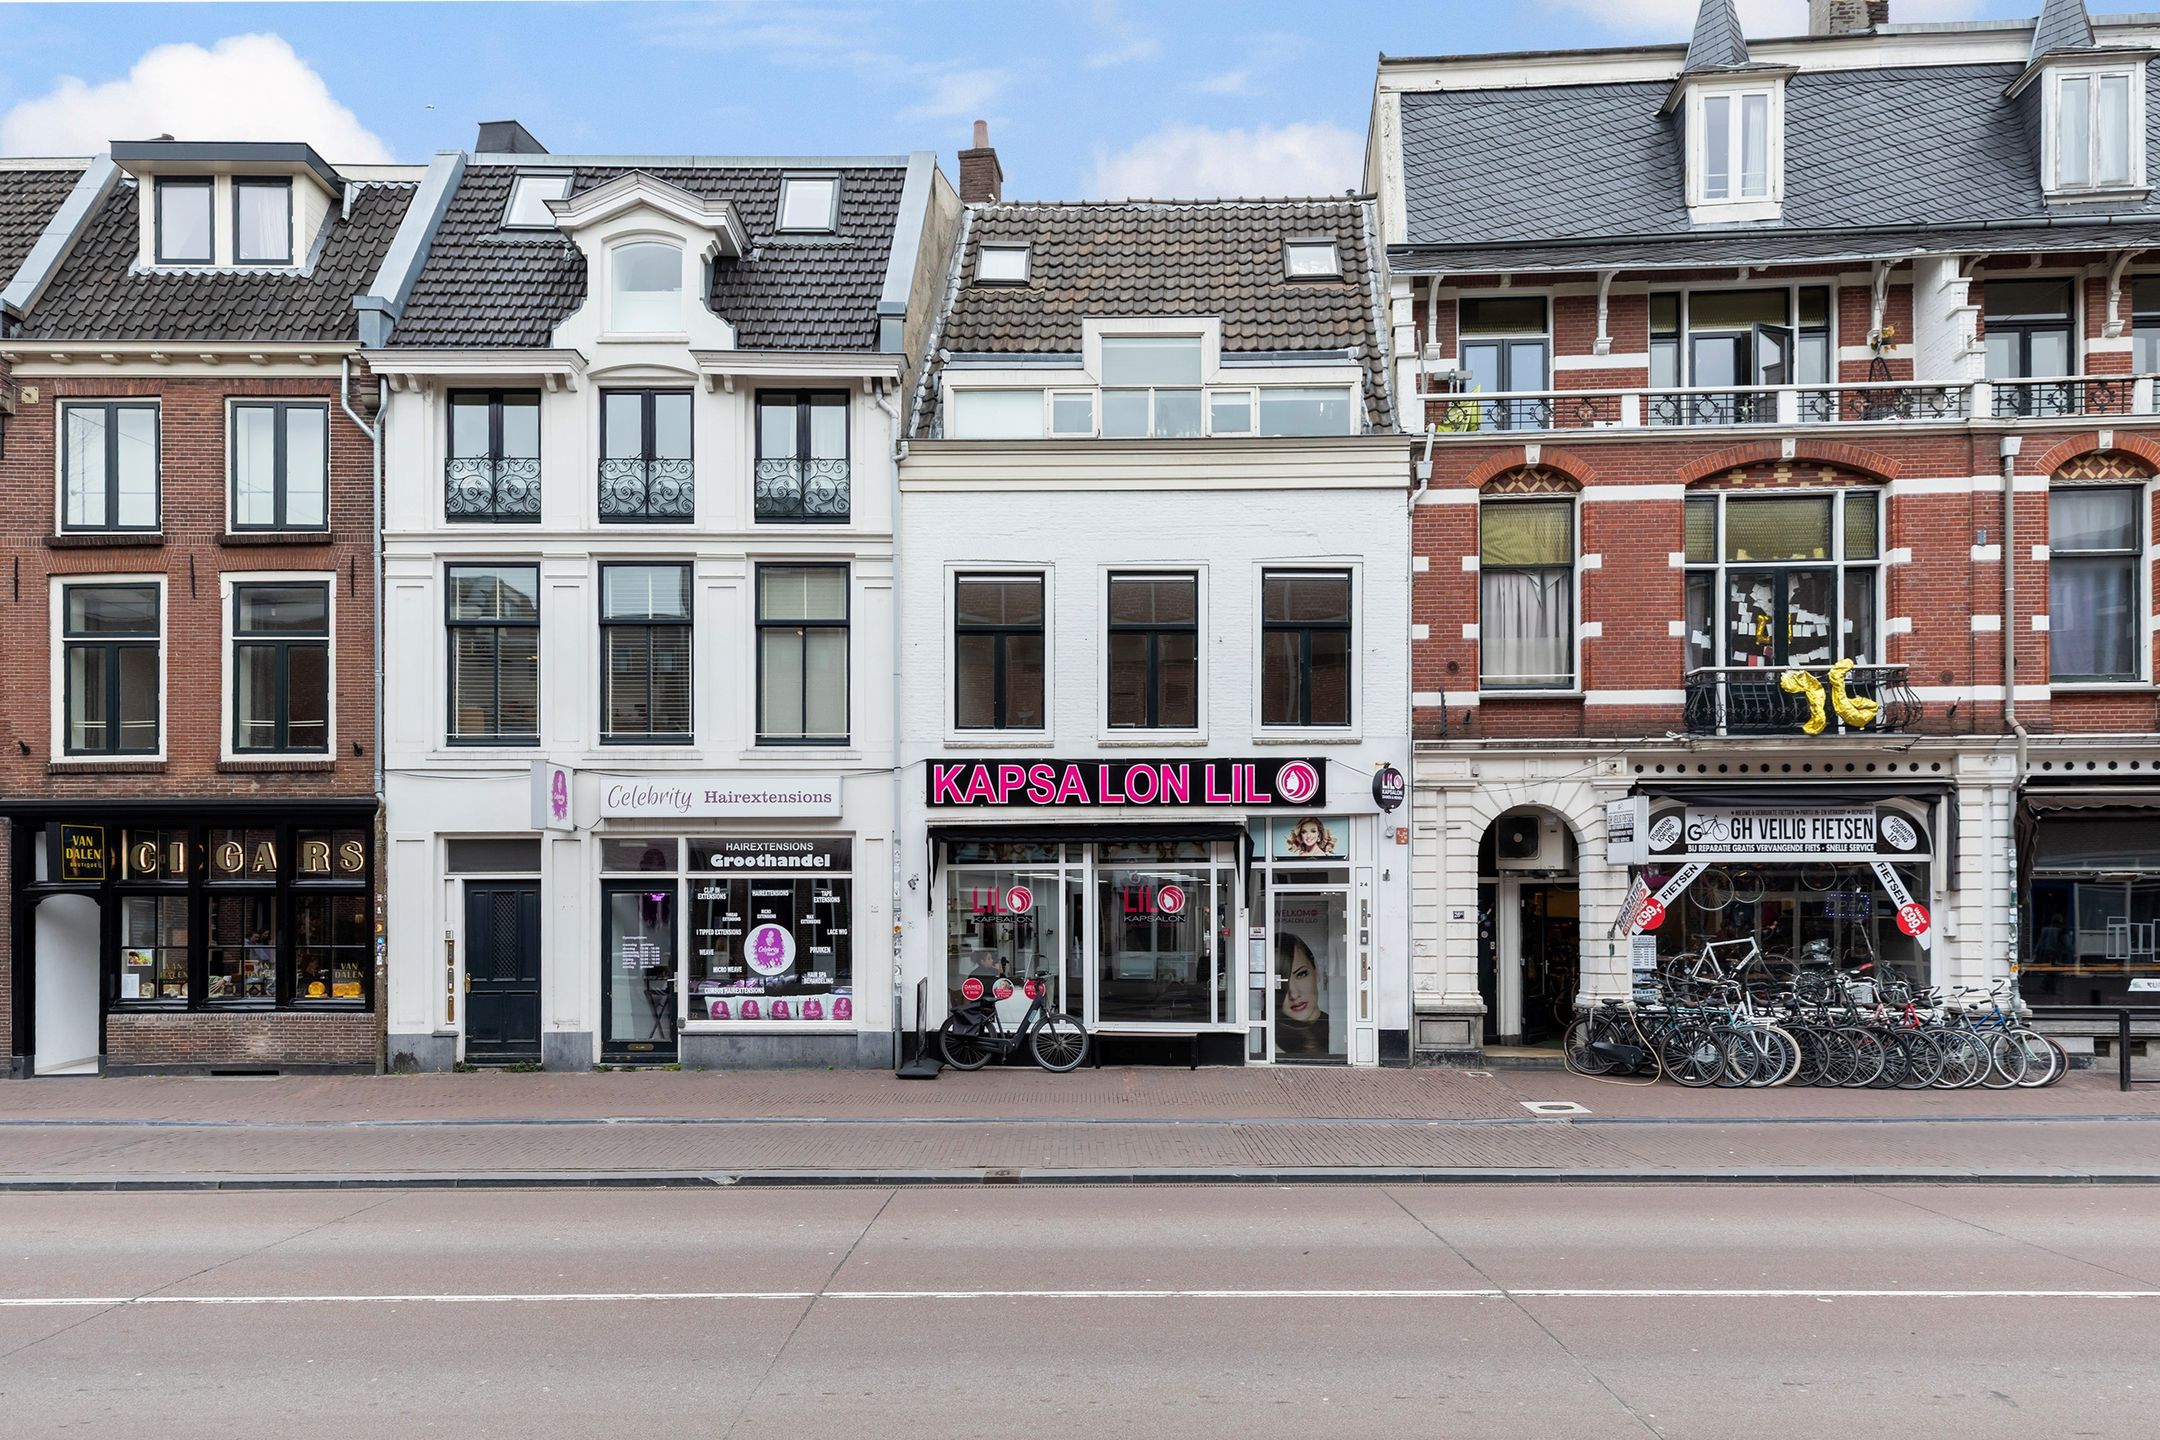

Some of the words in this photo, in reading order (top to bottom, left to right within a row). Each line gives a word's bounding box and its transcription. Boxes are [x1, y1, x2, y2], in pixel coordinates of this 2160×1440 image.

[1205, 764, 1272, 804] LIL
[608, 785, 692, 814] Celebrity
[704, 790, 832, 804] Hairextensions
[1650, 818, 1671, 841] STUDENTEN
[1657, 824, 1674, 842] KORTING
[1731, 818, 1752, 839] GH
[1759, 818, 1806, 839] VEILIG
[1812, 818, 1873, 839] FIETSEN
[1890, 825, 1909, 843] KORTING
[1892, 818, 1915, 840] STUDENTEN
[72, 835, 93, 846] VAN
[726, 842, 814, 851] HAIREXTENSIONS
[66, 848, 101, 860] DALEN
[710, 854, 830, 868] Groothandel
[1661, 864, 1698, 900] FIETSEN
[1877, 862, 1908, 904] FIETSEN
[1124, 886, 1158, 912] LIL
